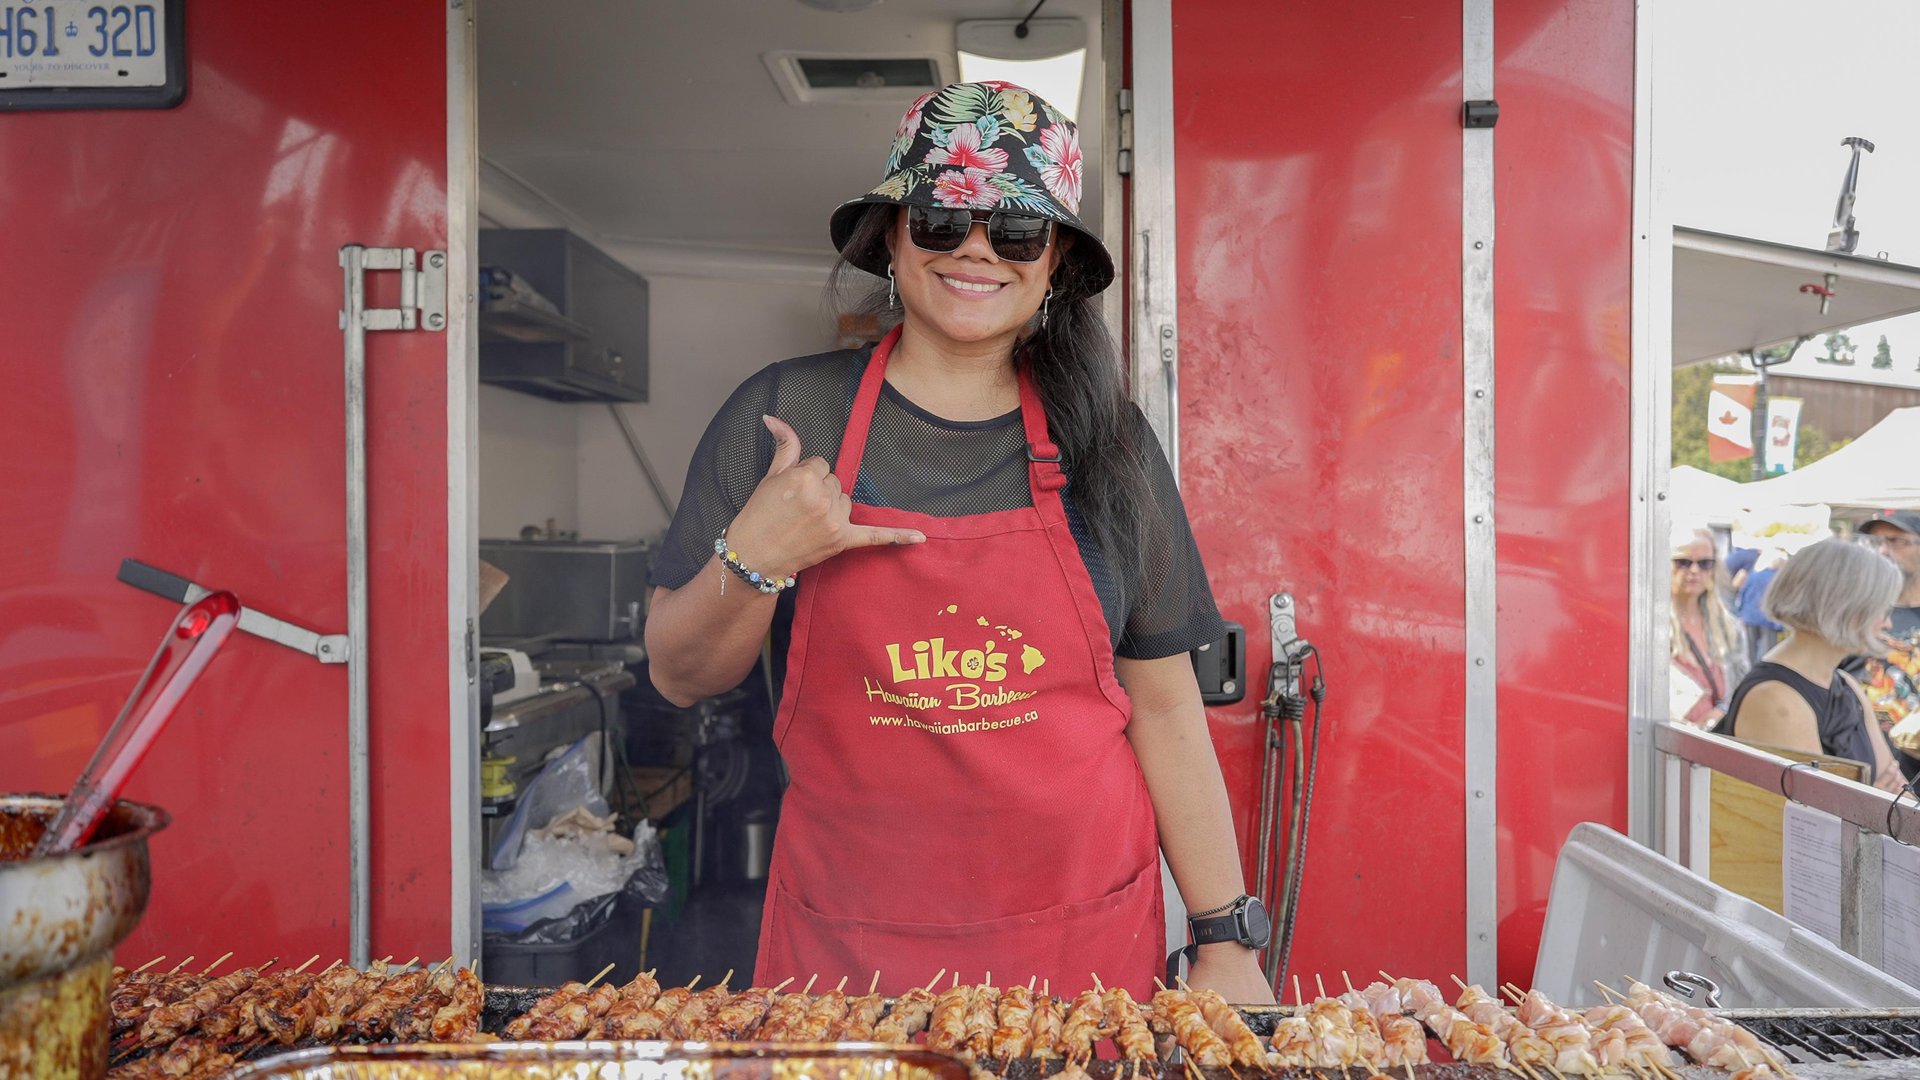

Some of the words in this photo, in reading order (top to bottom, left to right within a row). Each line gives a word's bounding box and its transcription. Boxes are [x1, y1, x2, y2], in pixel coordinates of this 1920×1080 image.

[87, 5, 156, 57] 32D
[14, 63, 44, 72] YOURS
[47, 63, 61, 71] TO
[63, 62, 110, 71] DISCOVER
[885, 637, 1008, 684] Liko's
[864, 676, 942, 710] Hawaiian
[869, 710, 1039, 735] www.hawaiianbarbecue.ca
